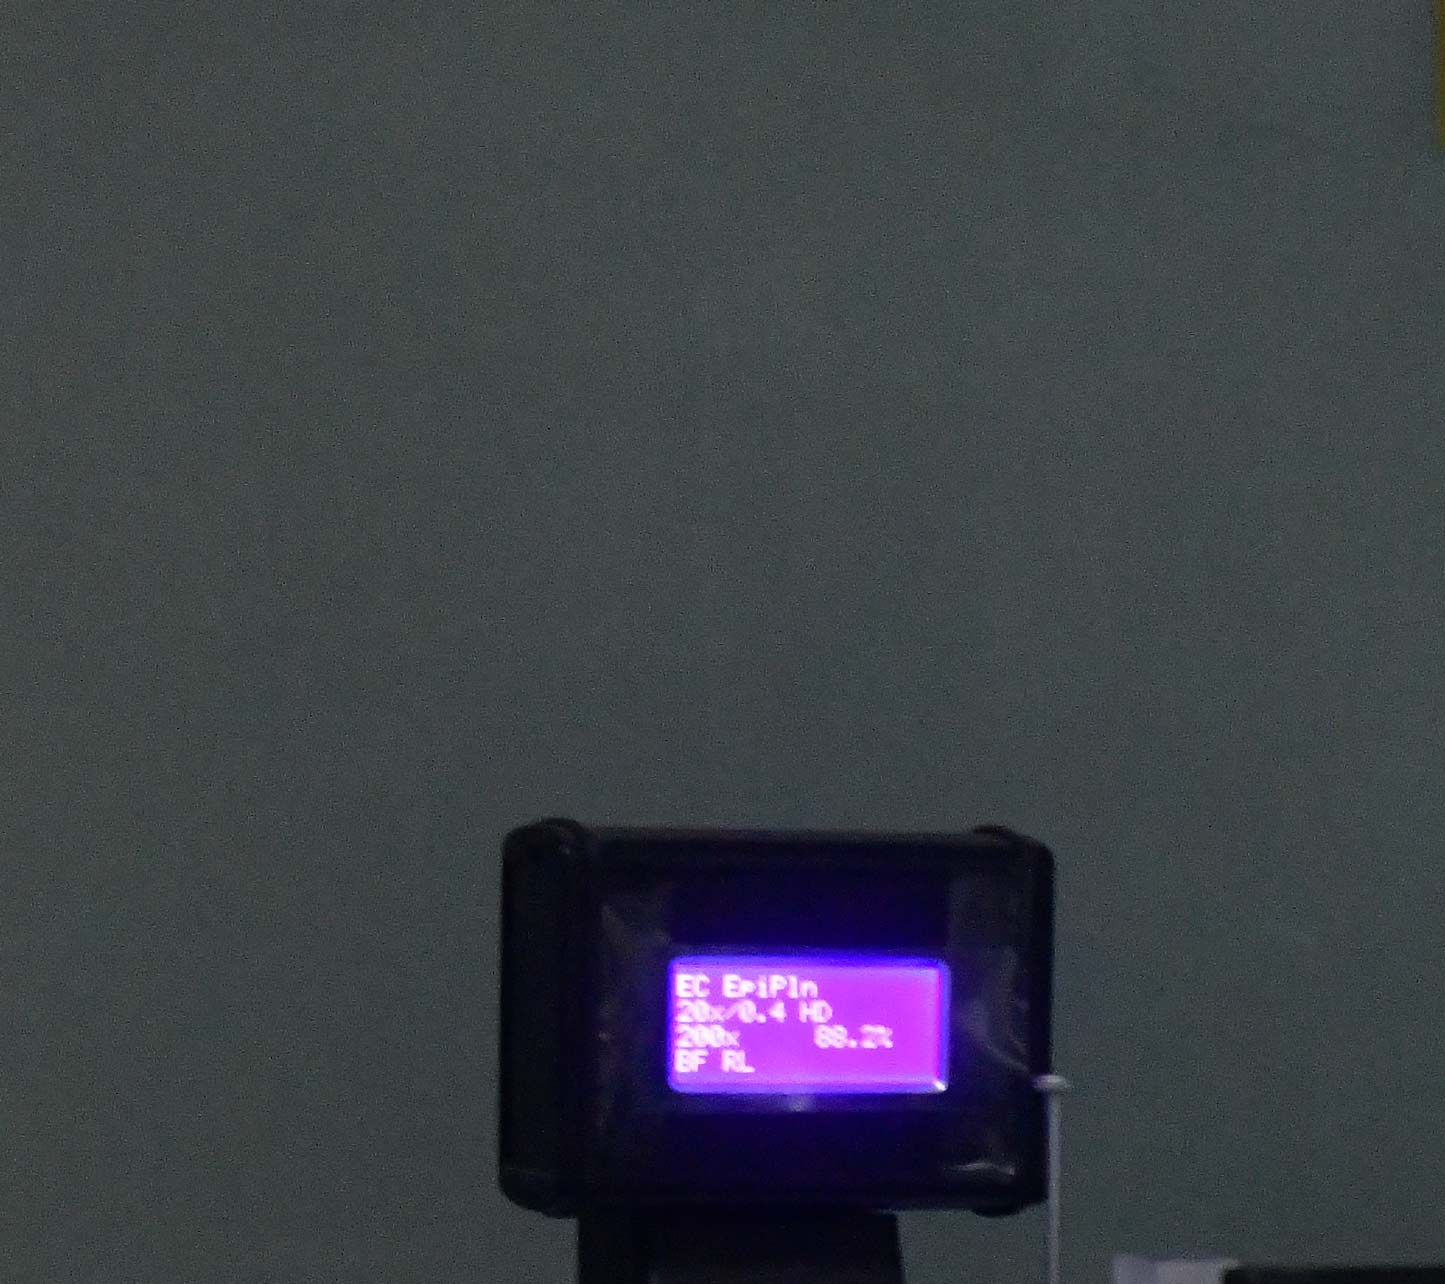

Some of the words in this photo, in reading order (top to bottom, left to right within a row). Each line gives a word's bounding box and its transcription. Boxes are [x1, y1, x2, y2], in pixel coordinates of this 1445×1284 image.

[675, 974, 710, 998] EC
[799, 1000, 832, 1023] HD
[675, 1050, 708, 1072] BF
